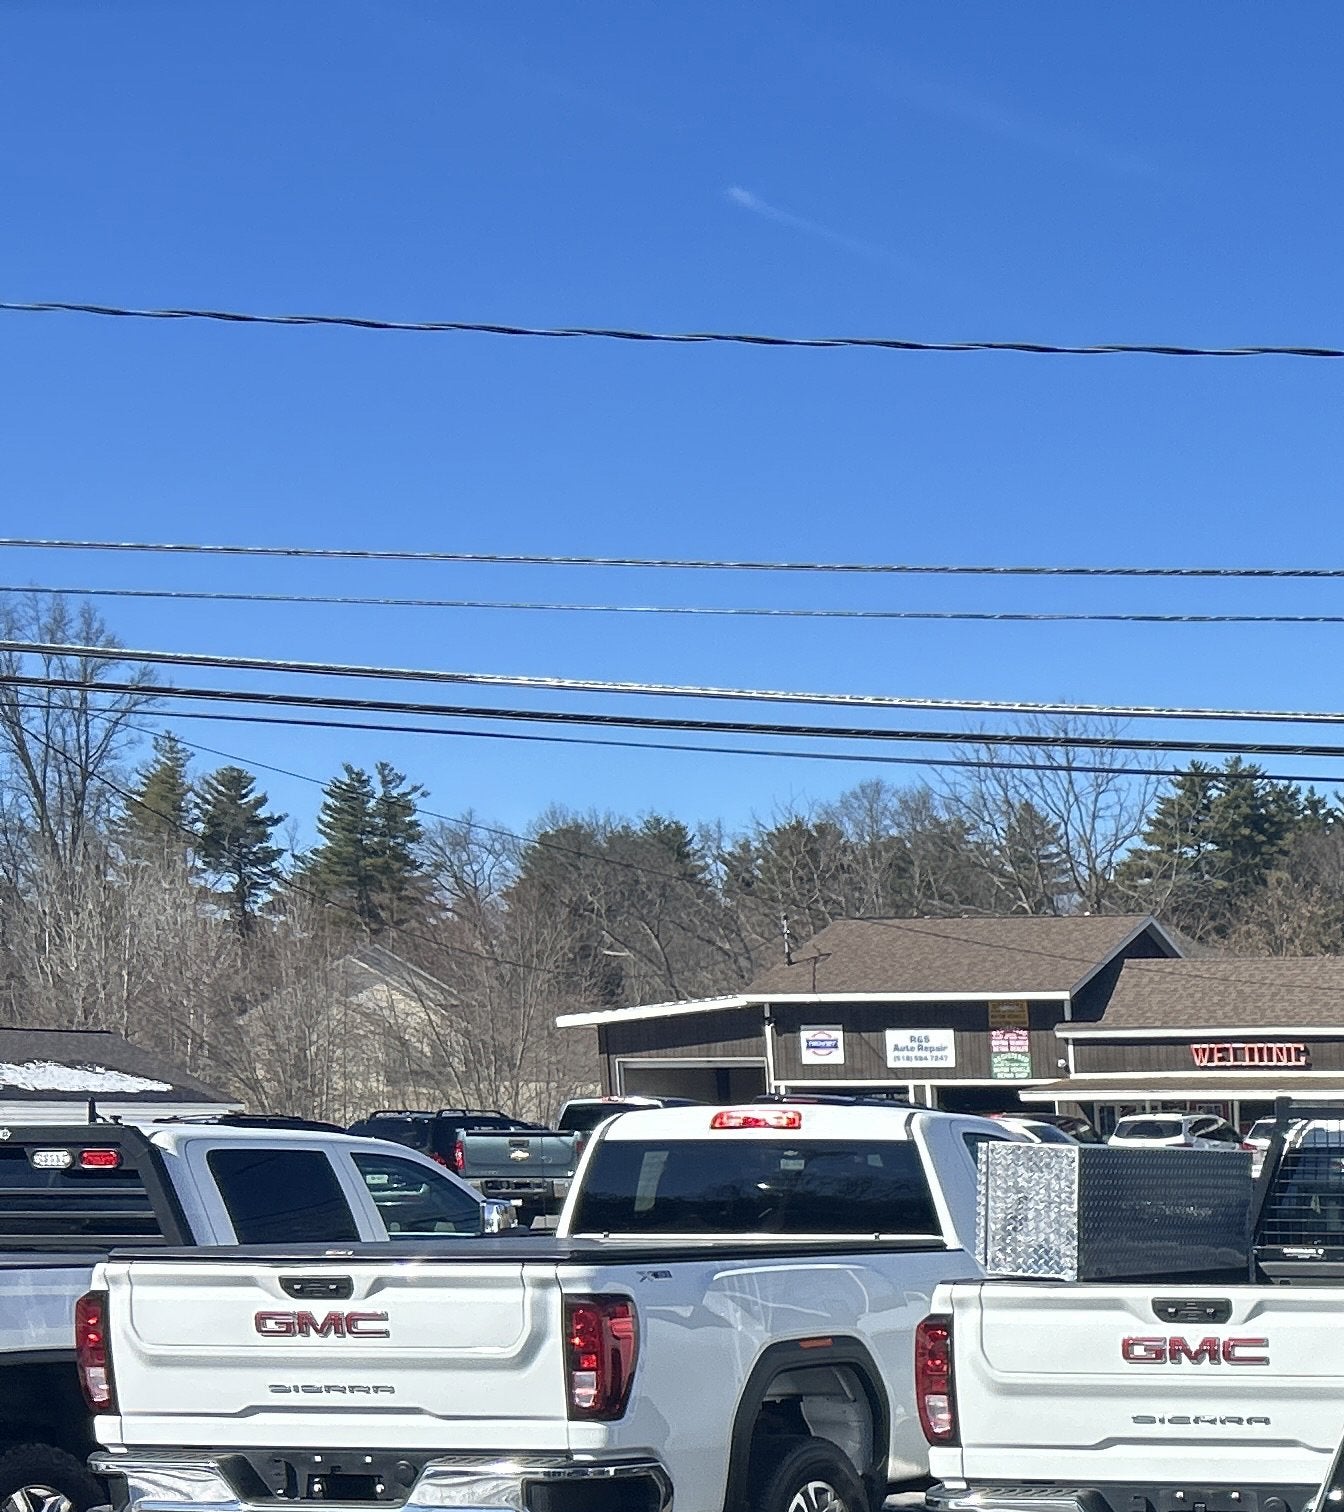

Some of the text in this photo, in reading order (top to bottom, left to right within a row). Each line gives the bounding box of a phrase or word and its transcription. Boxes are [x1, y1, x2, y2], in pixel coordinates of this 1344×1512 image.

[255, 1311, 390, 1338] GMC
[1122, 1336, 1270, 1366] GMC
[268, 1384, 395, 1394] SIERRA
[1131, 1415, 1271, 1425] SIERRA
